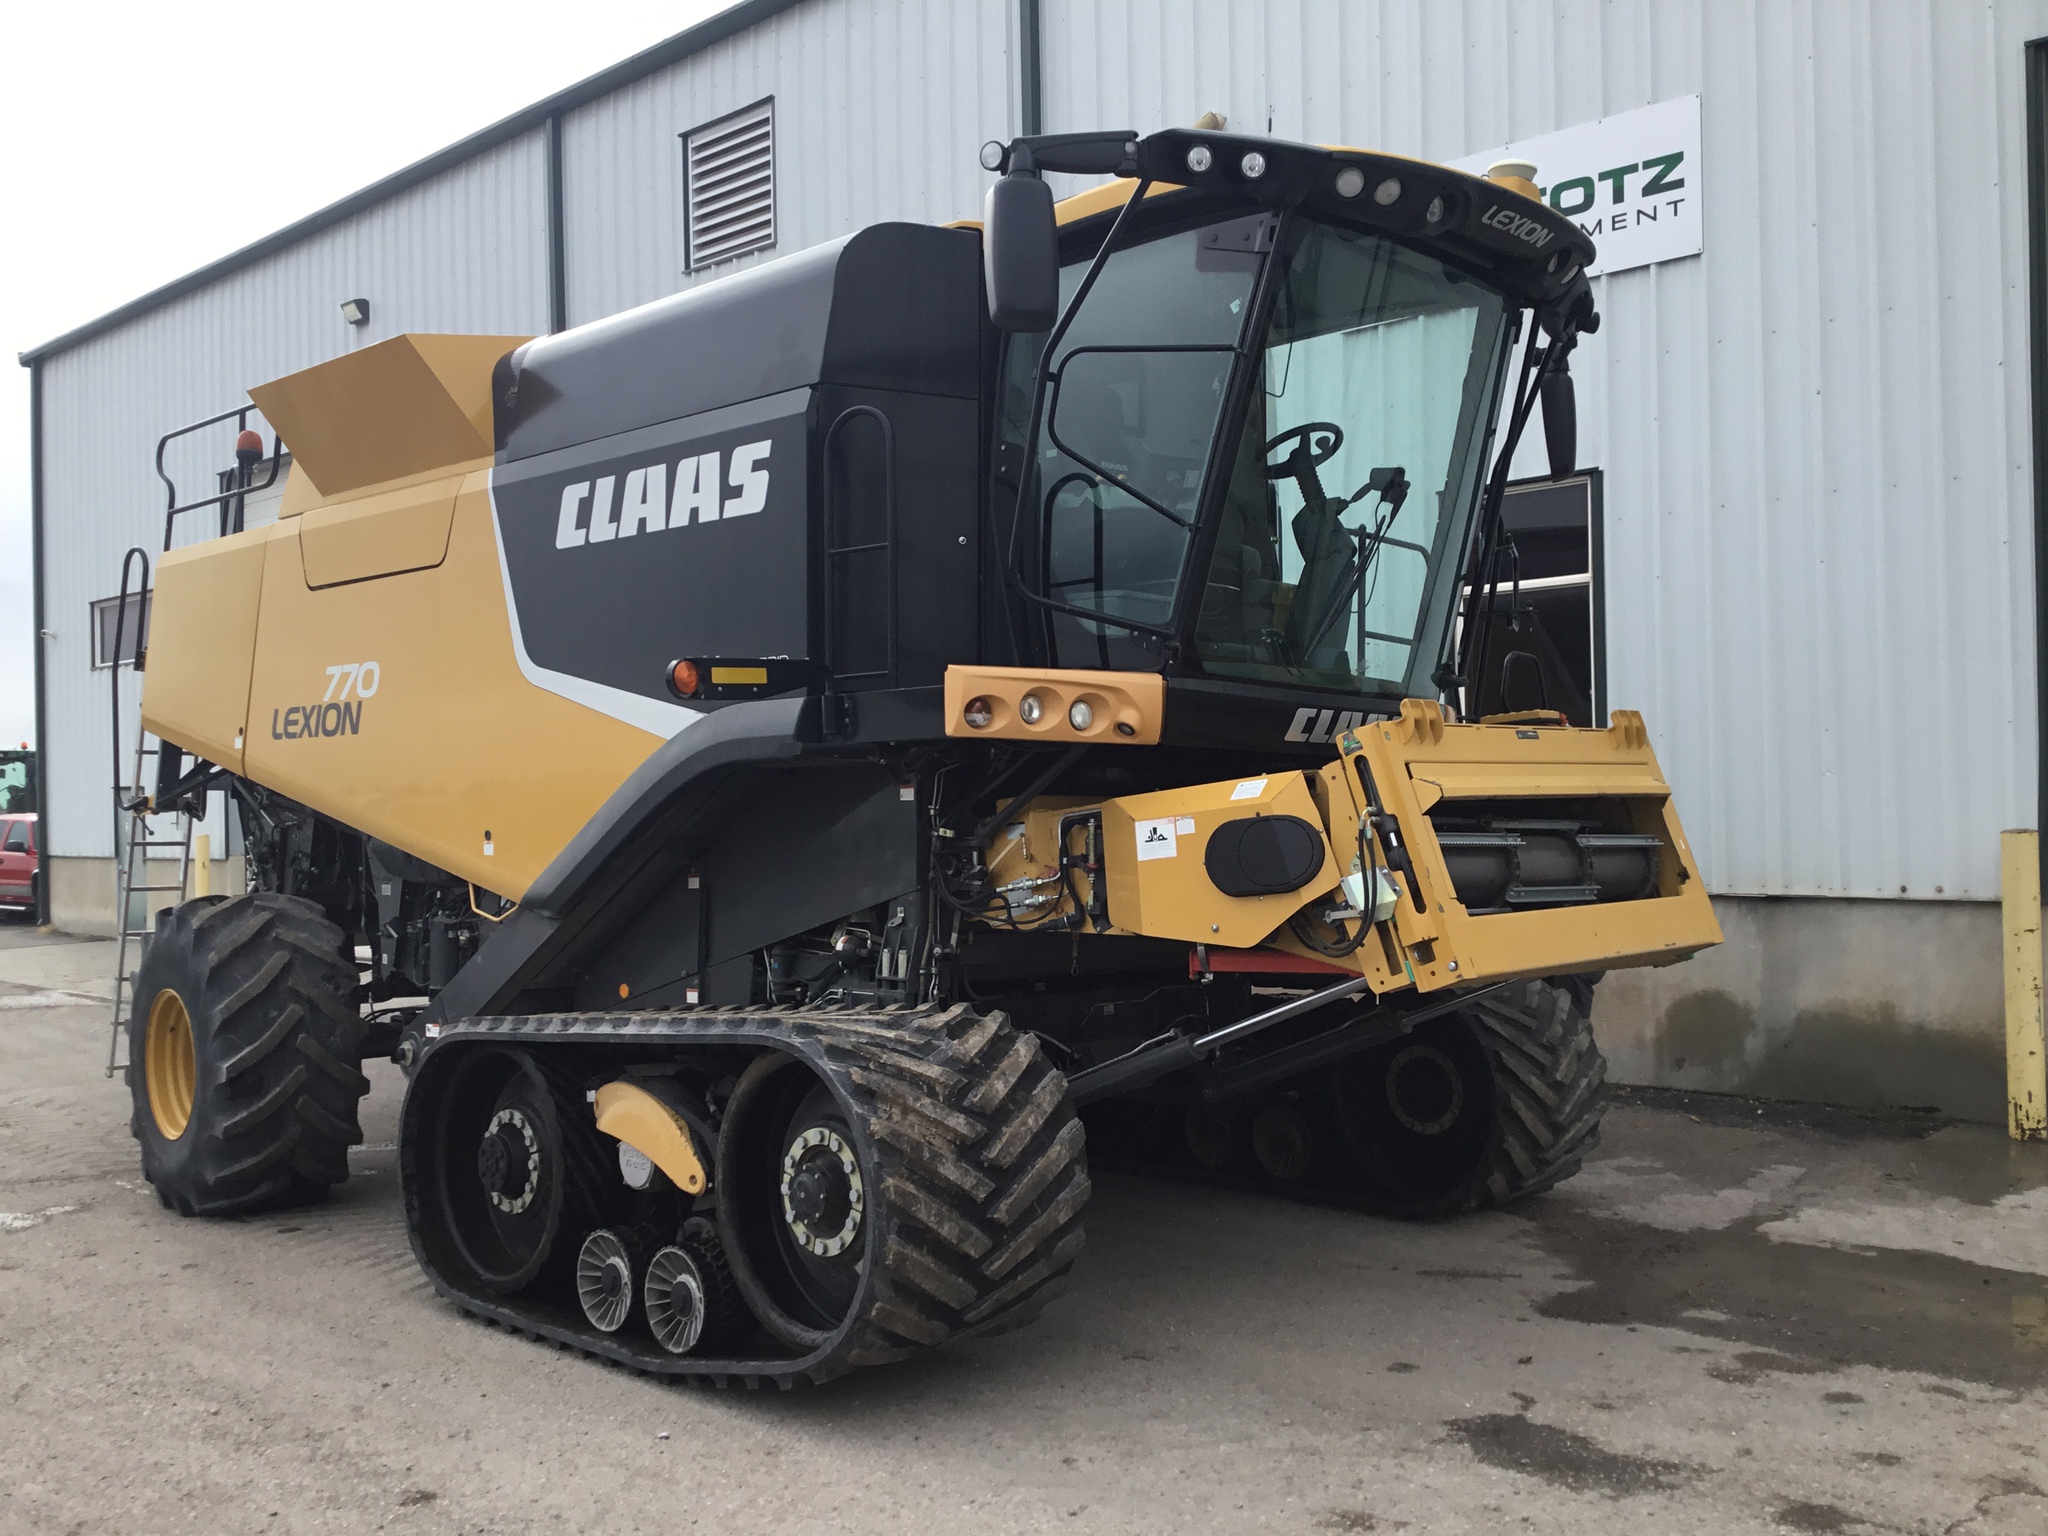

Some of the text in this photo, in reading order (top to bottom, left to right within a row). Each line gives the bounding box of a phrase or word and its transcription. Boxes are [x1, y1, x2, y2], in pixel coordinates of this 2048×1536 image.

[1539, 151, 1685, 217] OTZ
[1481, 204, 1555, 248] LEXION
[555, 439, 772, 550] CLAAS
[323, 661, 380, 702] 770
[272, 700, 363, 740] LEXION
[1284, 707, 1402, 744] CLA
